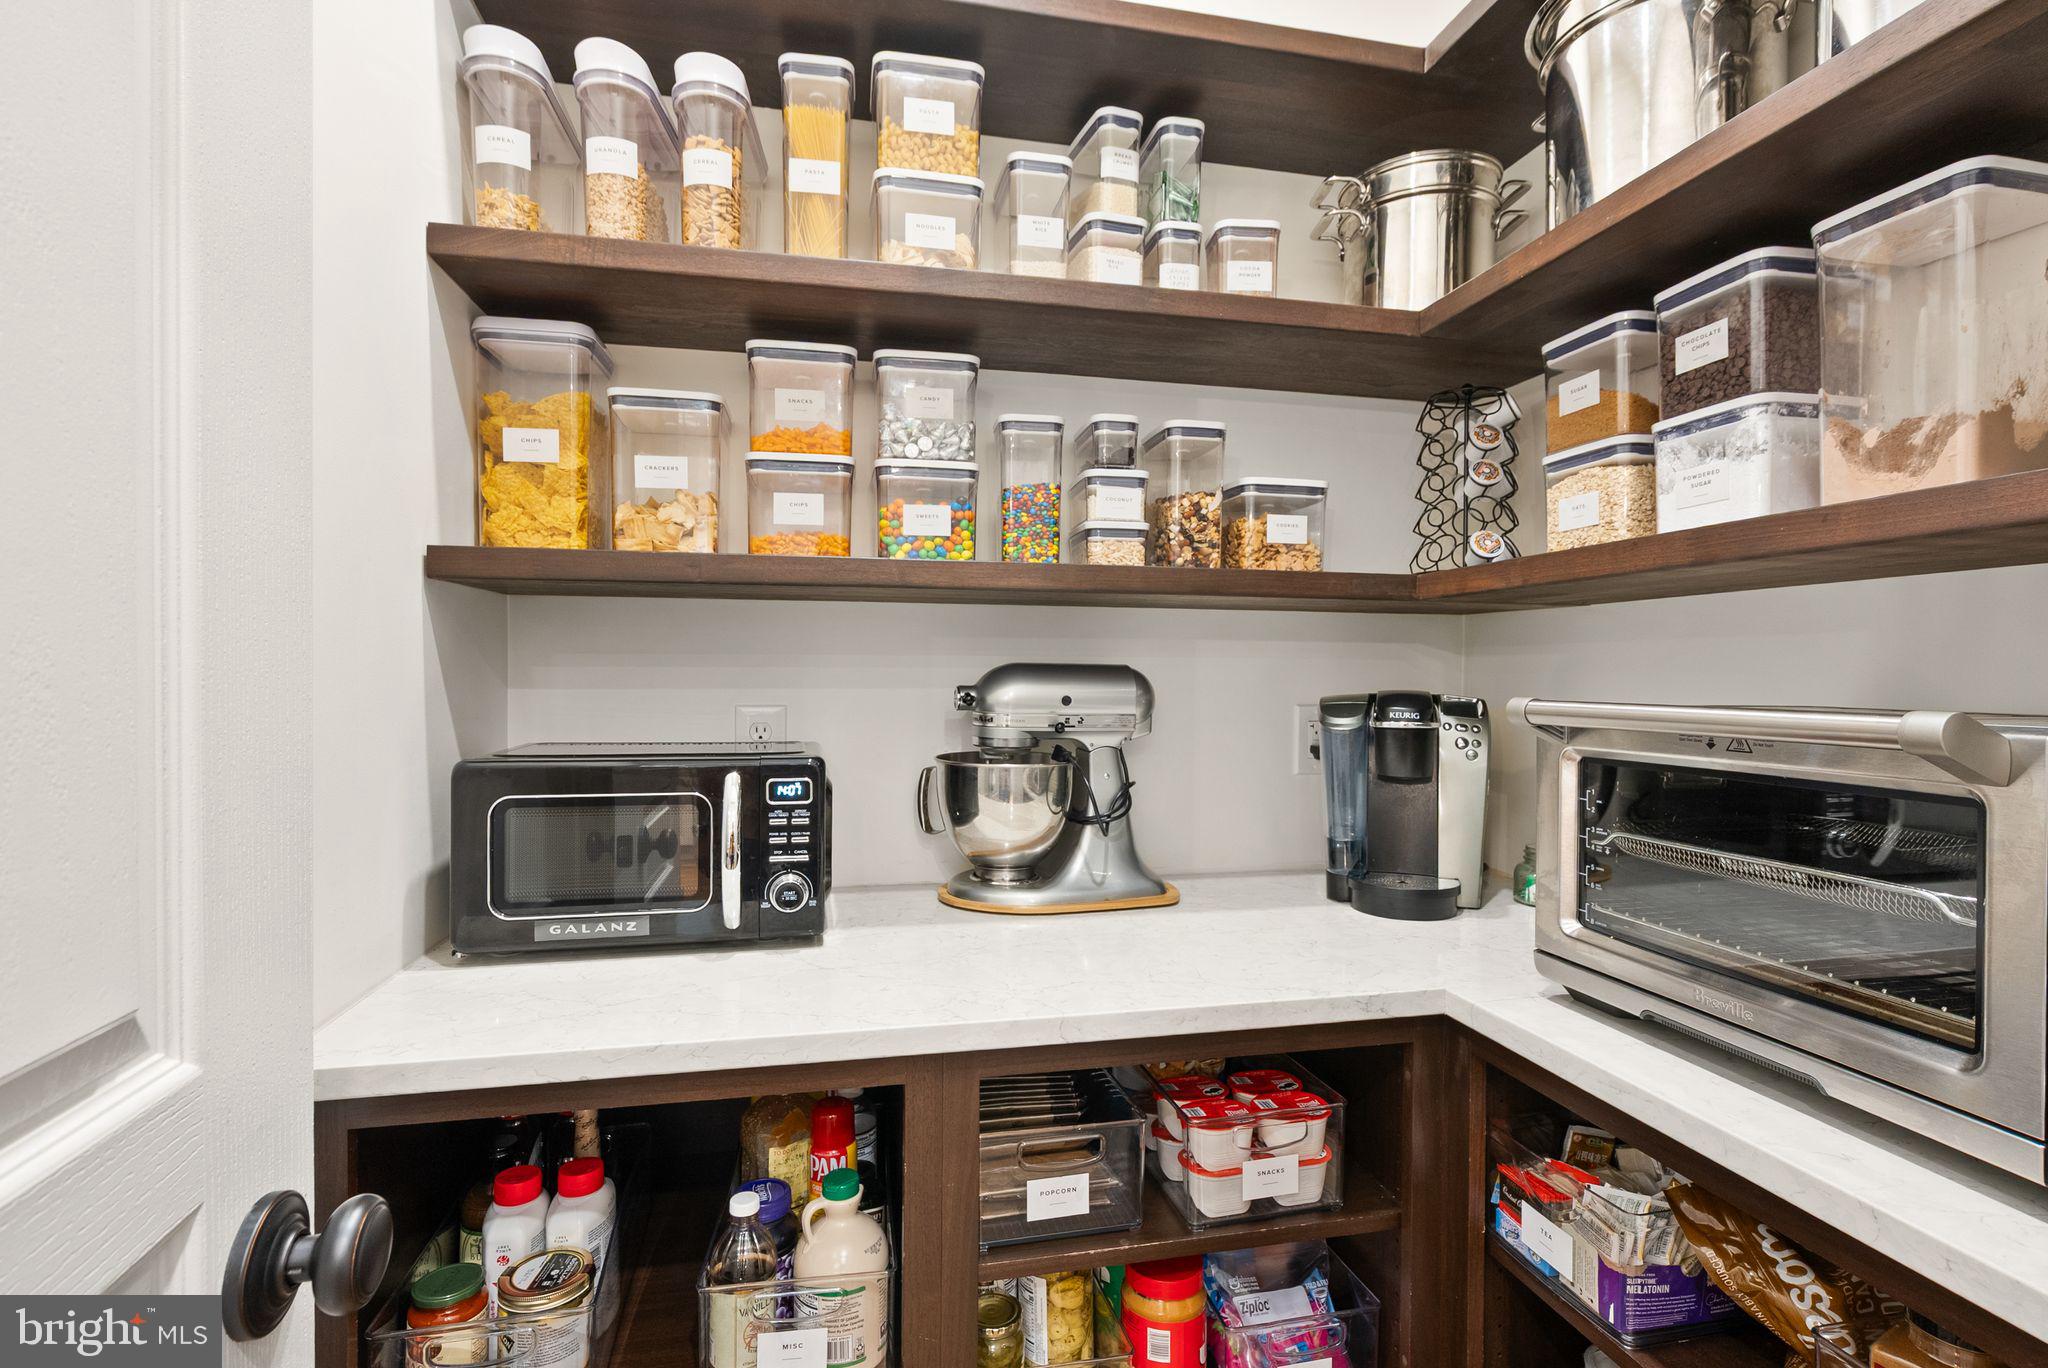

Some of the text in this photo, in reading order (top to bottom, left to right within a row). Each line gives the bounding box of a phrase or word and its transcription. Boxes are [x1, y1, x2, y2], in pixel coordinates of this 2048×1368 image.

[487, 135, 516, 145] CEREAL
[594, 147, 628, 157] GRANOLA
[693, 158, 719, 166] CEREAL
[916, 223, 946, 231] NOODLES
[1681, 327, 1721, 348] CHOCOLATE
[1691, 341, 1710, 352] CHIPS
[1570, 384, 1588, 394] SUGAR
[644, 464, 679, 472] CRACKERS
[1683, 468, 1721, 482] POWDERED
[1691, 480, 1712, 489] SUGAR
[1389, 711, 1420, 720] KEURIG
[549, 921, 637, 935] GALANZ
[1695, 985, 1754, 1022] Breville
[810, 1153, 848, 1181] PAM
[1257, 1167, 1285, 1177] SNACKS
[1040, 1187, 1077, 1197] POPCORN
[1539, 1227, 1553, 1241] TEA
[1705, 1250, 1737, 1292] SOURCED
[1626, 1284, 1670, 1294] MELATONIN
[1240, 1299, 1270, 1317] Ziploc
[782, 1342, 804, 1350] MISC
